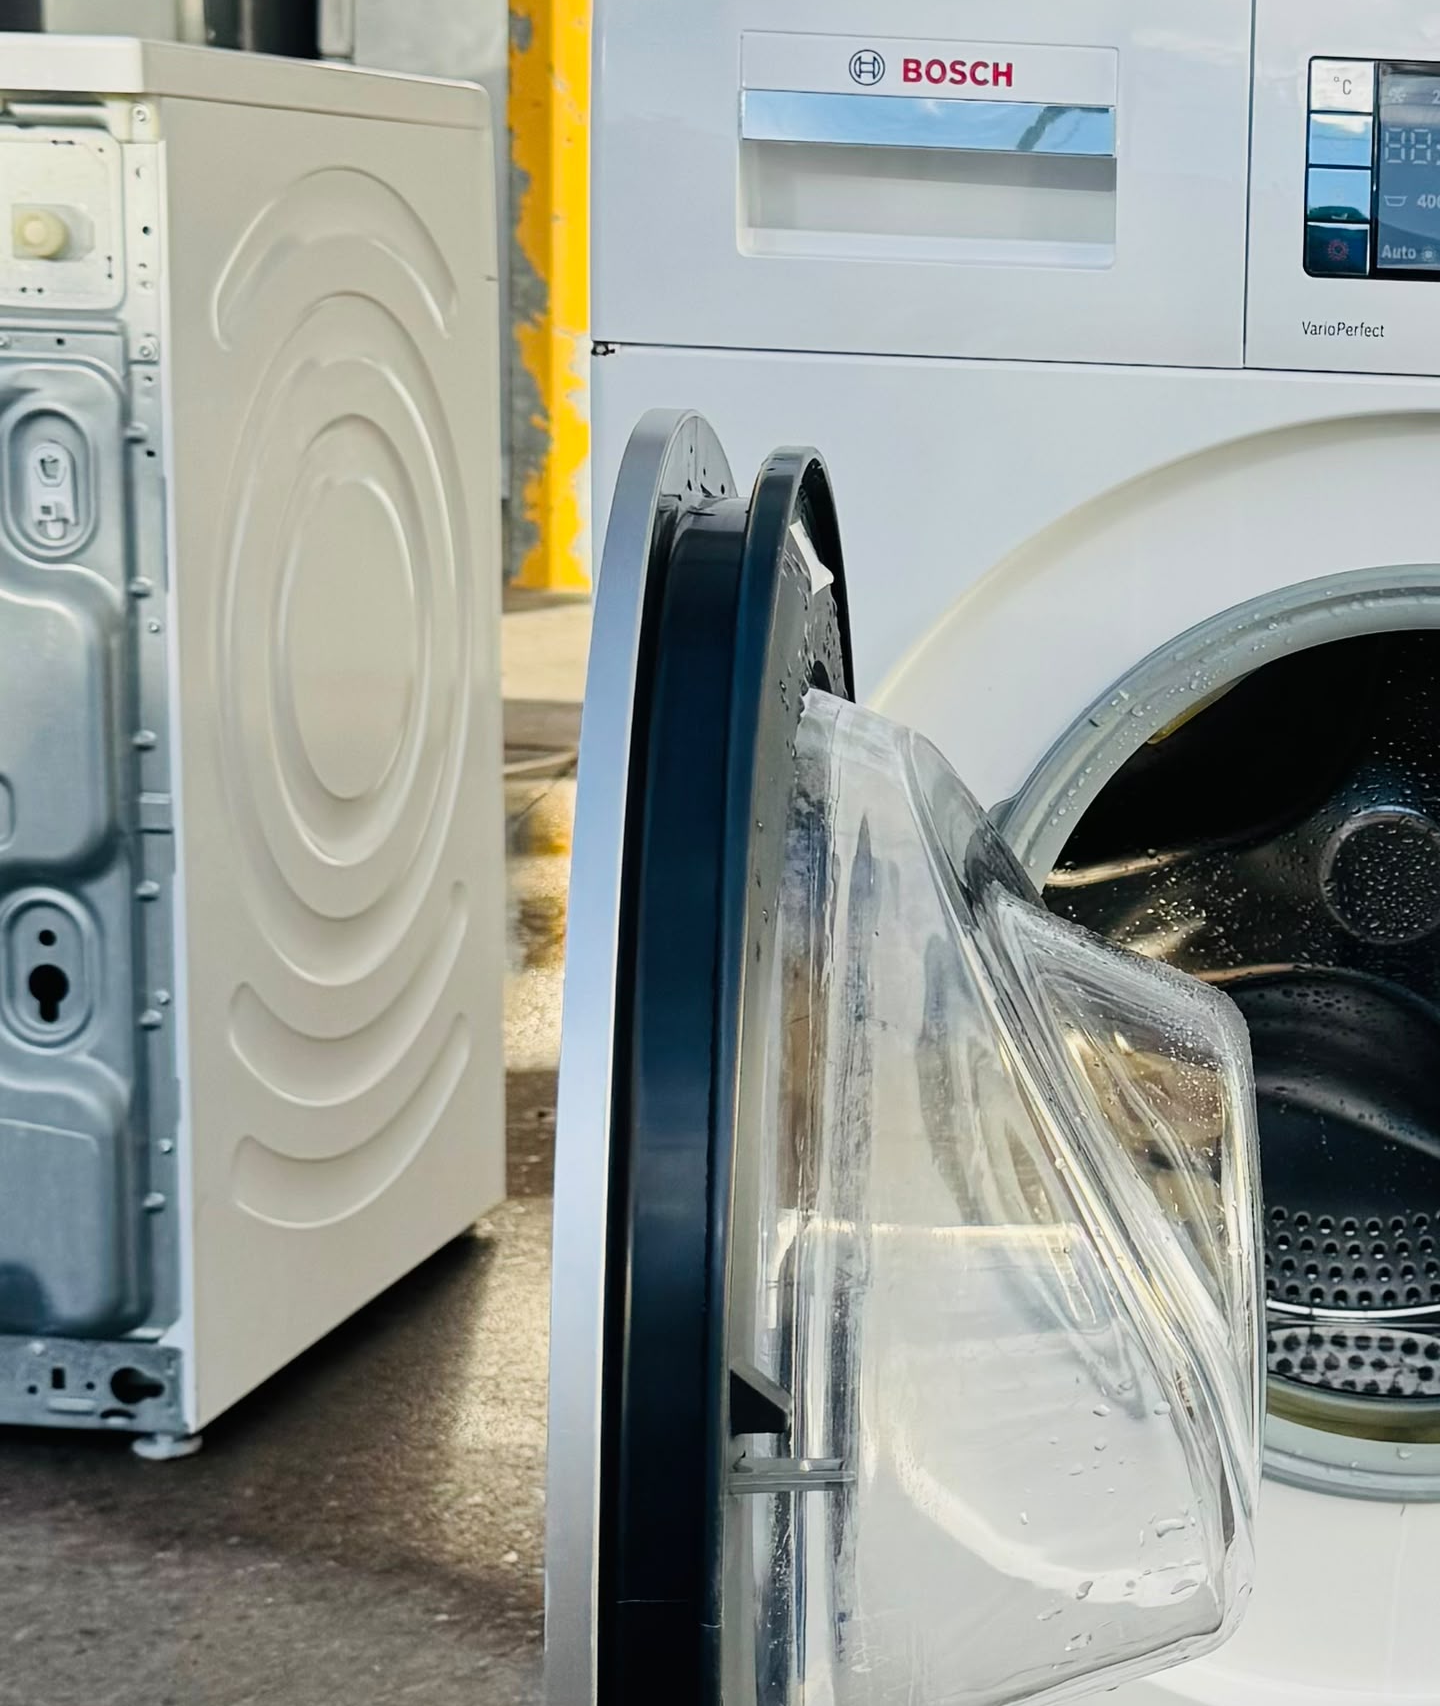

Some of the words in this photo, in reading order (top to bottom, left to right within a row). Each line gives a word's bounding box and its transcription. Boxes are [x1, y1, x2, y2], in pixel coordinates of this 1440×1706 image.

[903, 58, 1013, 87] BOSCH
[1381, 244, 1417, 261] Auto
[1302, 321, 1385, 339] VarioPerfect
